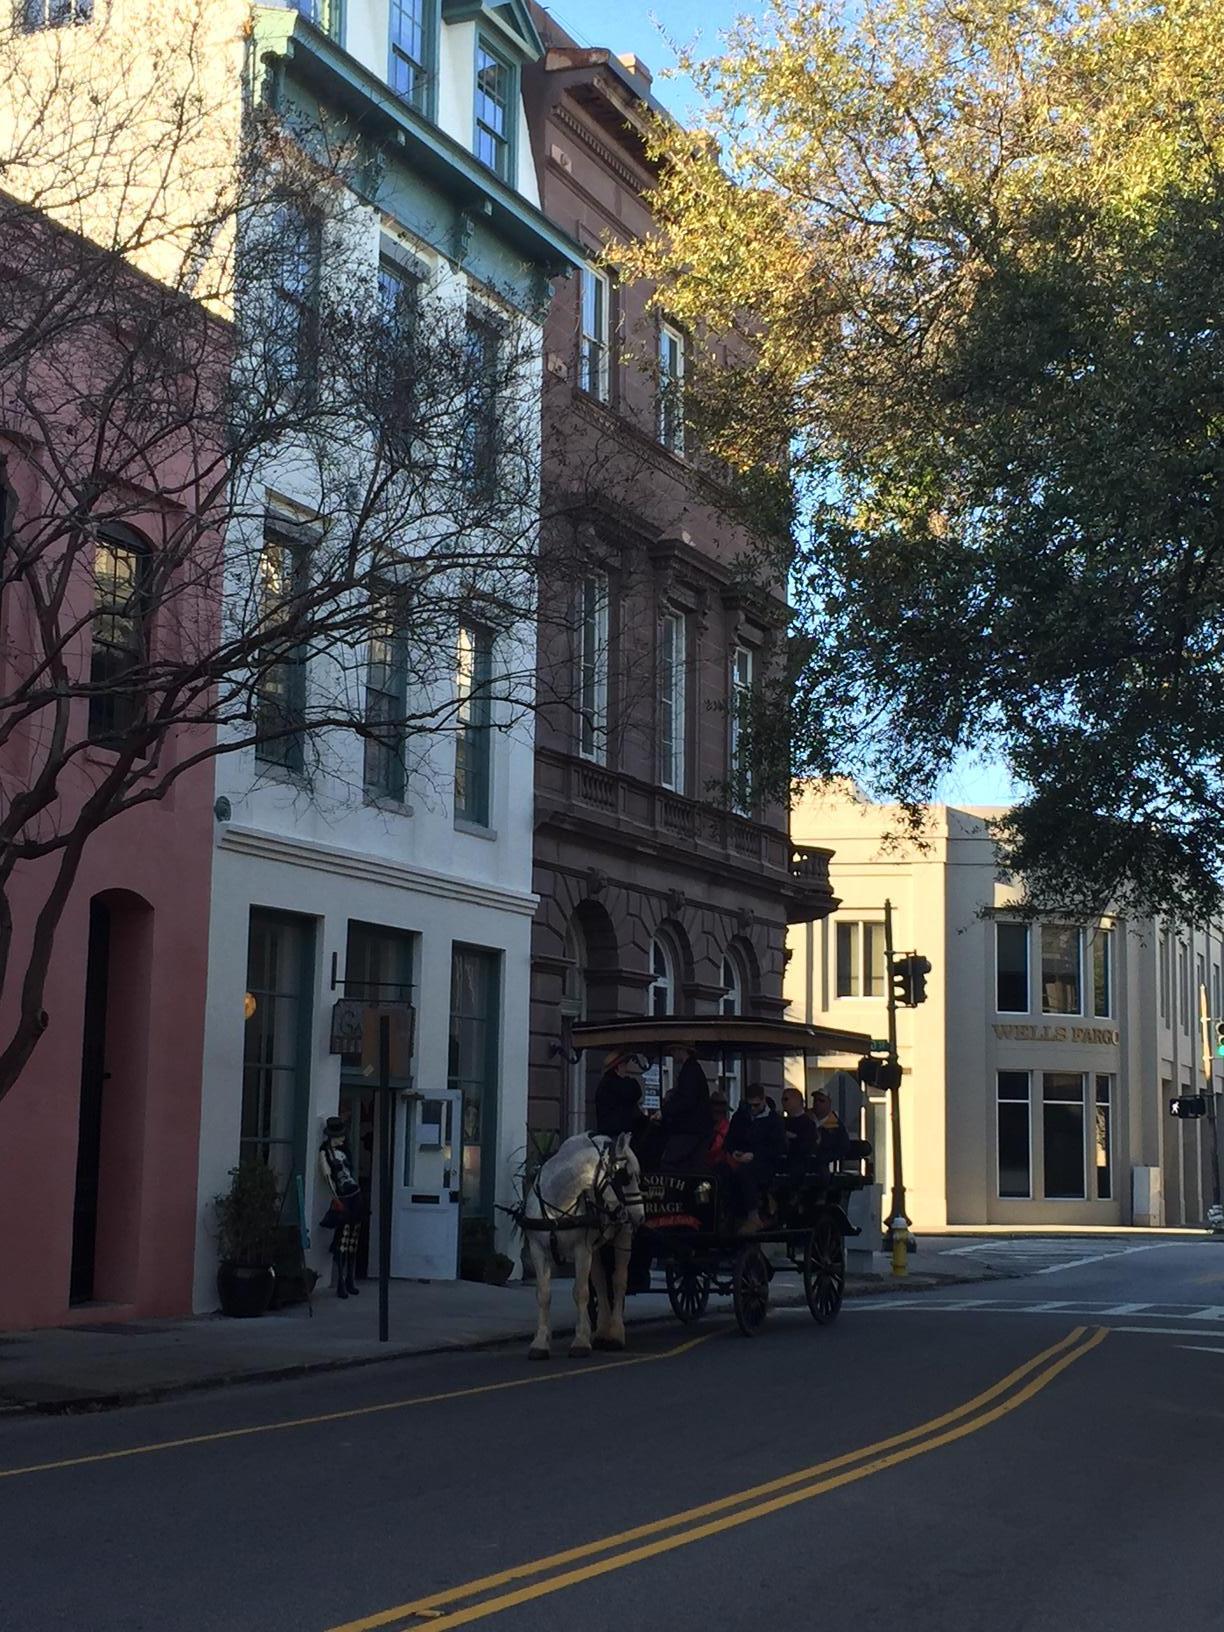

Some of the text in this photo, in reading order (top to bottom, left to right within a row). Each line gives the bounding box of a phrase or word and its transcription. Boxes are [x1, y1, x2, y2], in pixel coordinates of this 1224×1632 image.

[992, 1024, 1120, 1046] WELLS FARGO
[643, 1175, 686, 1191] SOUTH
[646, 1200, 682, 1213] RIAGE
